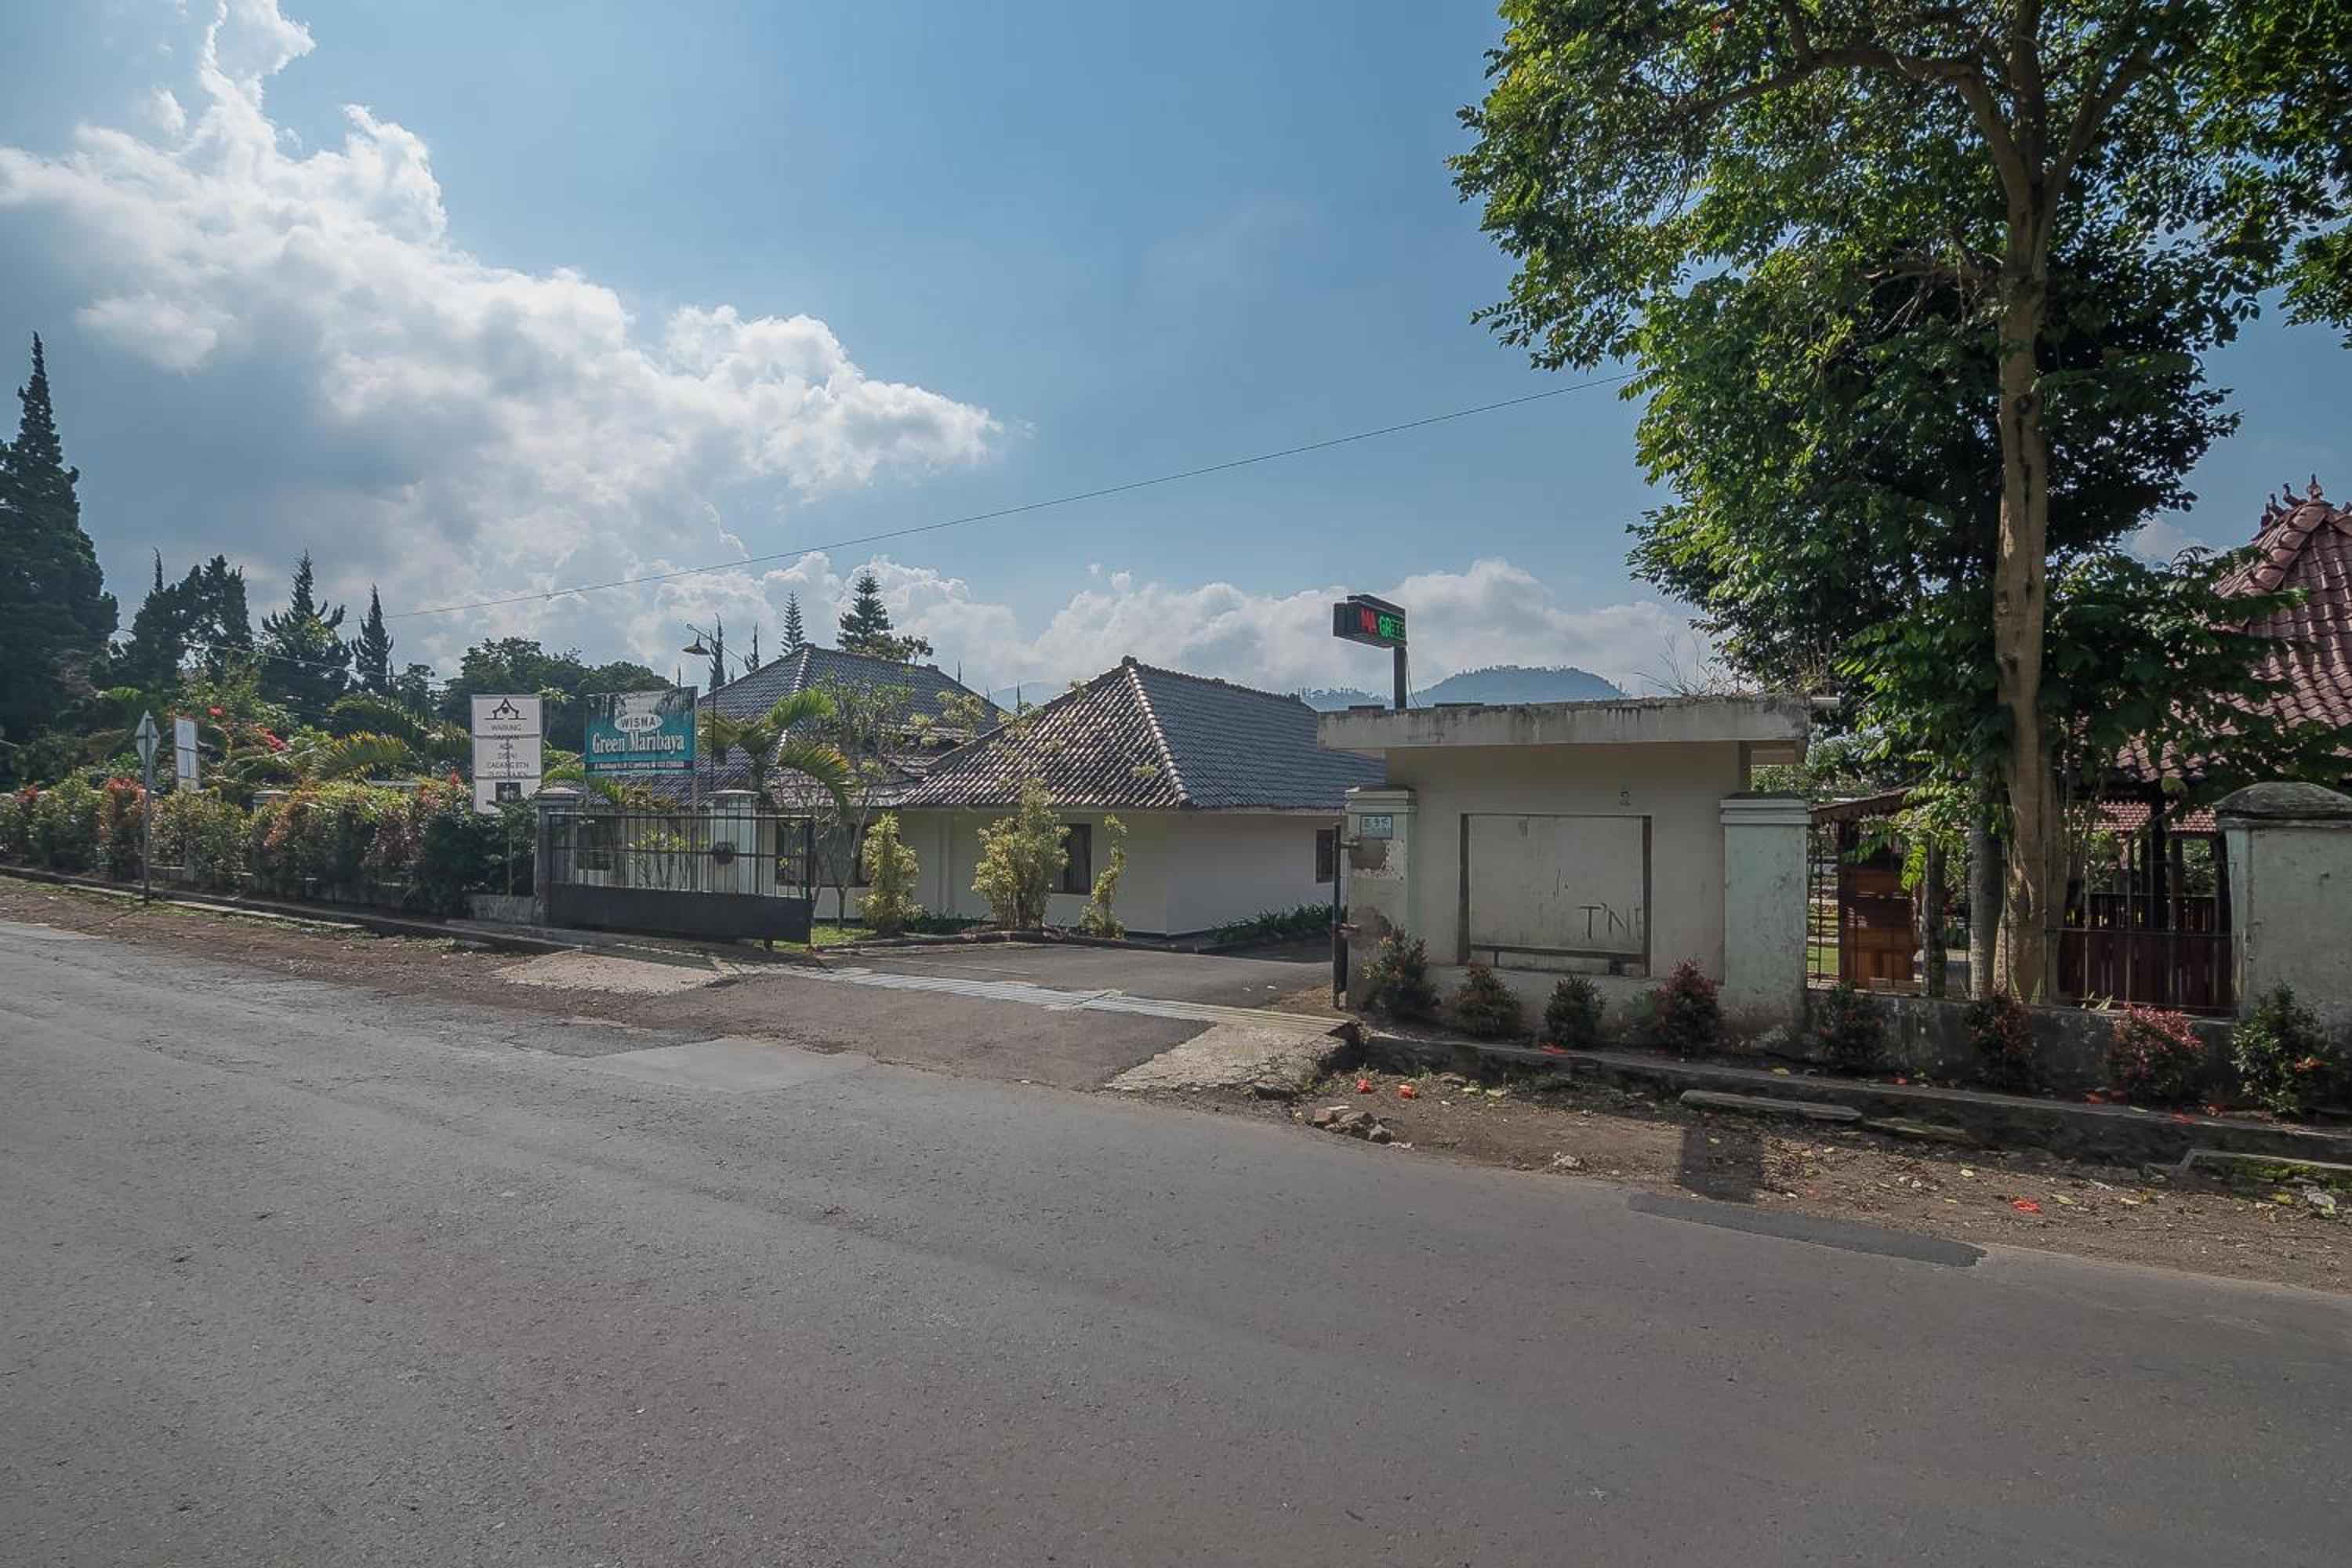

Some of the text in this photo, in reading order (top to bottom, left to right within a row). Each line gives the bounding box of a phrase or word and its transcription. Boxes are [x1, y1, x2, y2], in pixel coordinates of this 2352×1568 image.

[620, 716, 657, 728] WISMA
[592, 728, 684, 756] Green Maribaya
